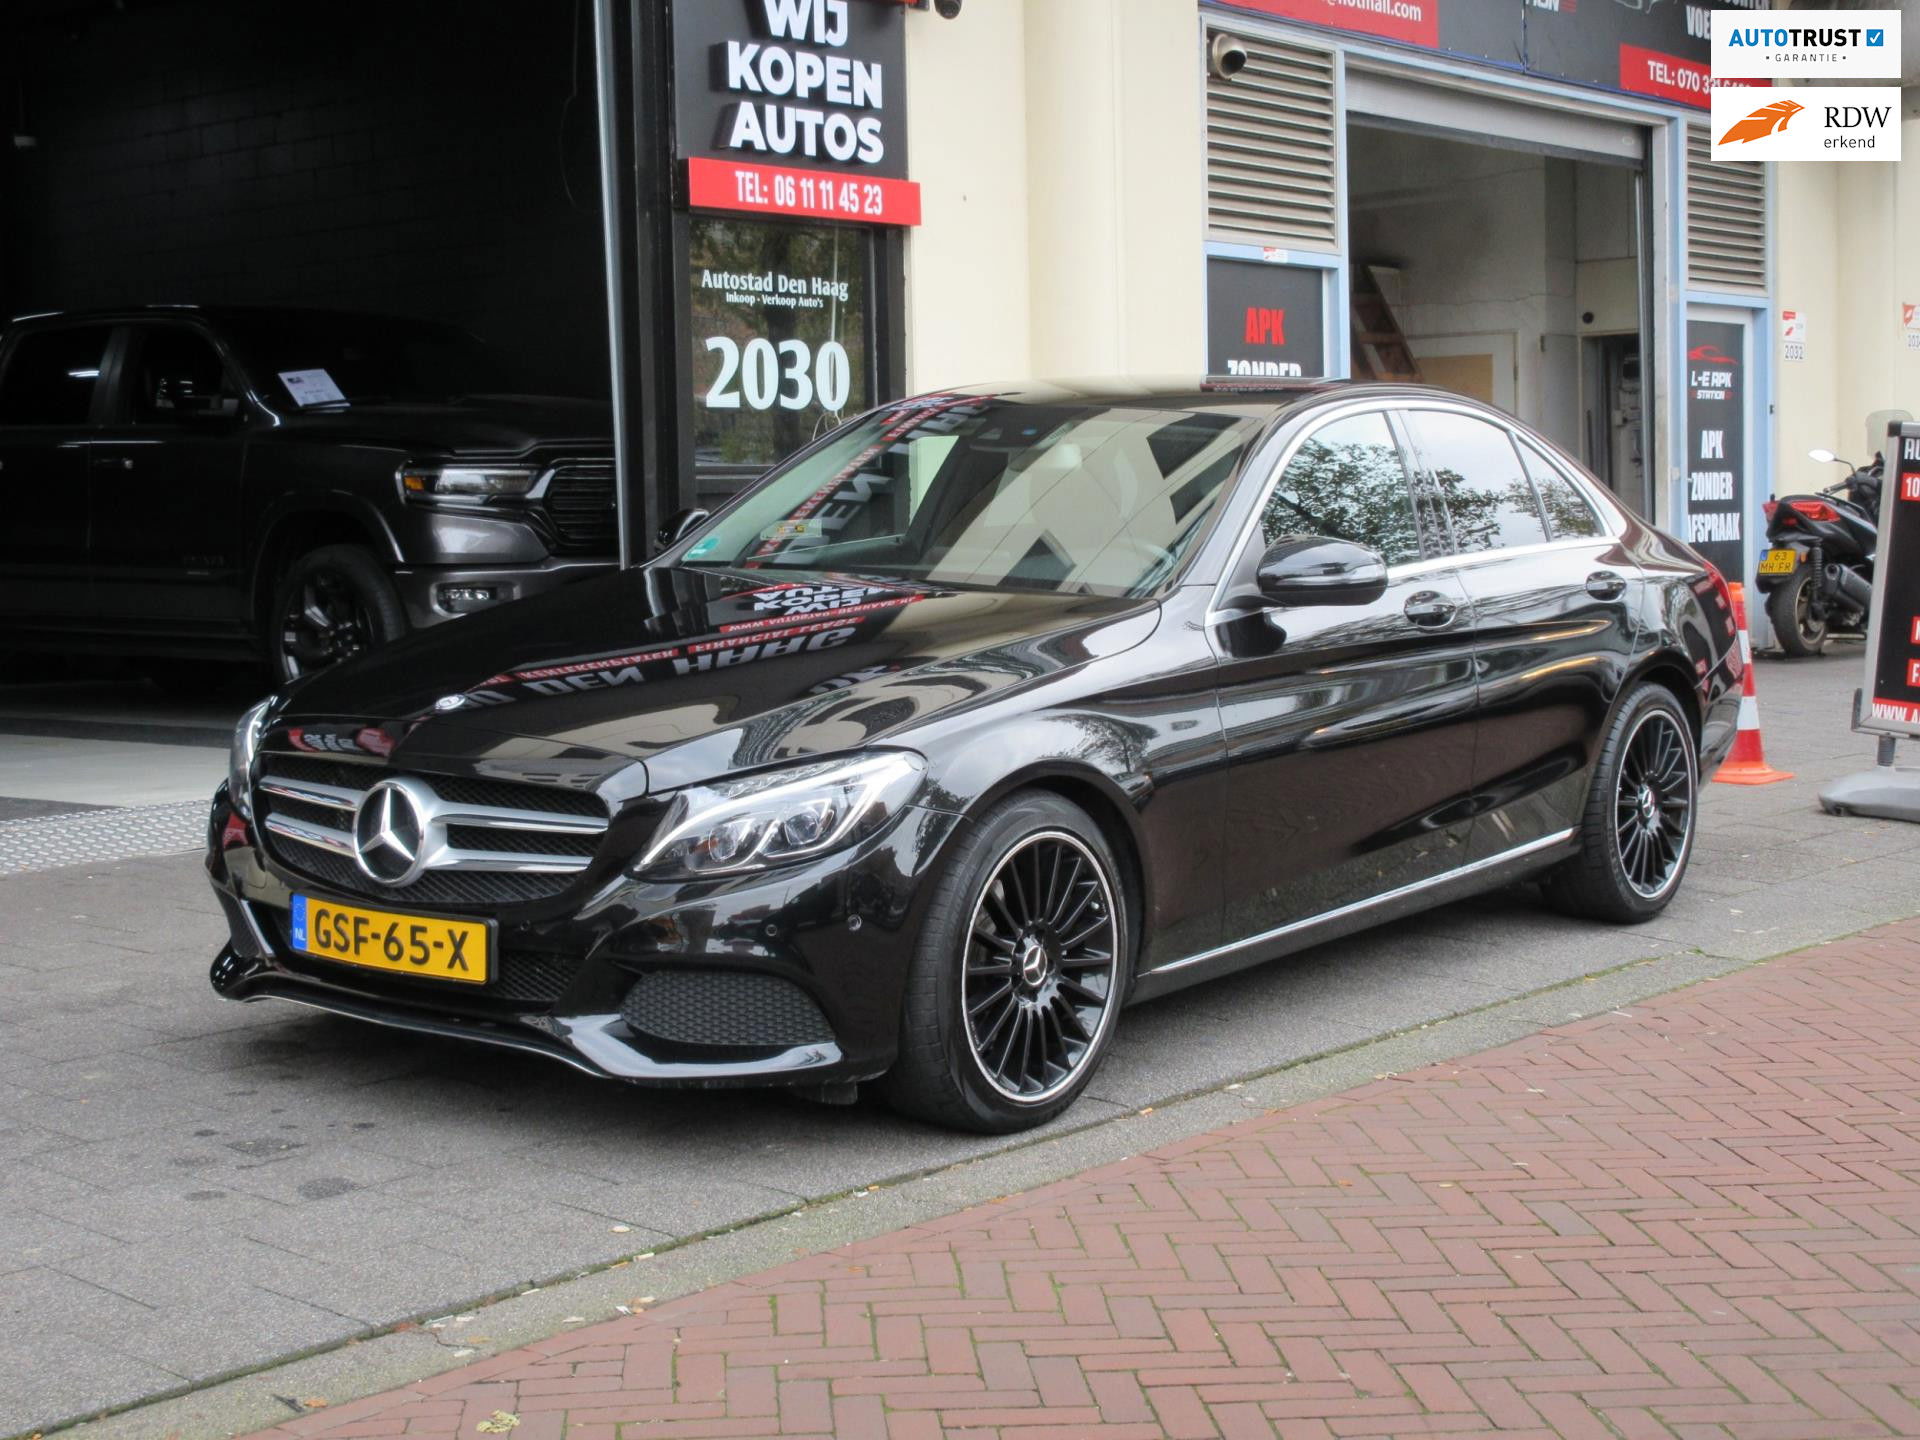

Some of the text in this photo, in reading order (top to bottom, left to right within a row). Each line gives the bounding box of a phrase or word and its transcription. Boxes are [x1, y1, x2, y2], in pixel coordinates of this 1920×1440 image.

[762, 0, 848, 47] WIJ
[727, 40, 883, 109] KOPEN
[1648, 60, 1675, 85] TEL:
[1677, 68, 1700, 92] 070
[729, 101, 884, 163] AUTOS
[735, 170, 883, 215] TEL: 06 11 11 45 23
[702, 269, 849, 301] Autostad Den Haag
[726, 291, 756, 307] Inkoop
[762, 294, 796, 309] Verkoop
[798, 297, 824, 308] Auto's
[1245, 307, 1286, 345] APK
[705, 336, 850, 410] 2030
[1701, 430, 1724, 459] APK
[1691, 472, 1733, 501] ZONDER
[294, 927, 306, 941] NL
[314, 907, 470, 972] GSF-65-X
